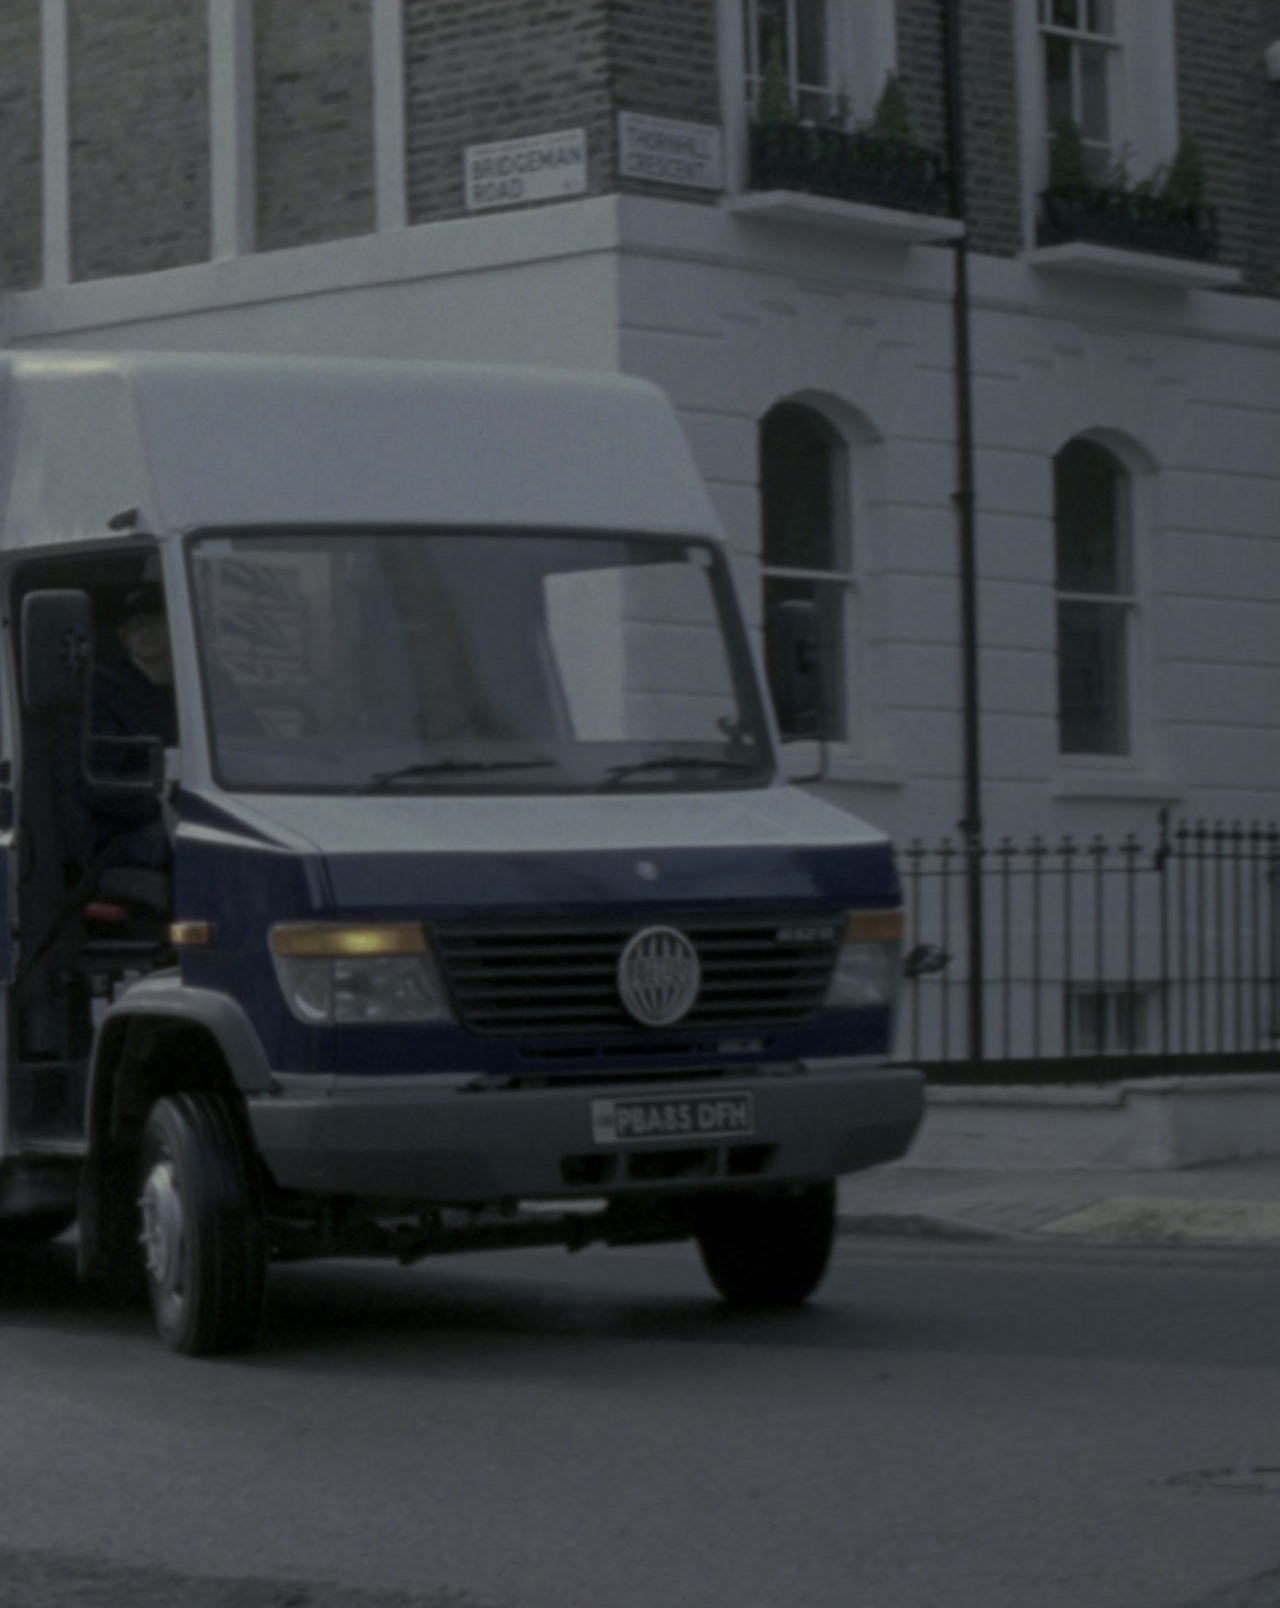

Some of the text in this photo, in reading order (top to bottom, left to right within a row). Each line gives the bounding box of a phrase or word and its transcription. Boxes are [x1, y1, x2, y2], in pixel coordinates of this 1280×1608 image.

[626, 126, 712, 159] THORNHILL
[473, 147, 581, 180] BRIDGEMAN
[627, 152, 706, 180] CRESCENT
[473, 177, 525, 201] ROAD
[697, 1101, 748, 1130] DFH
